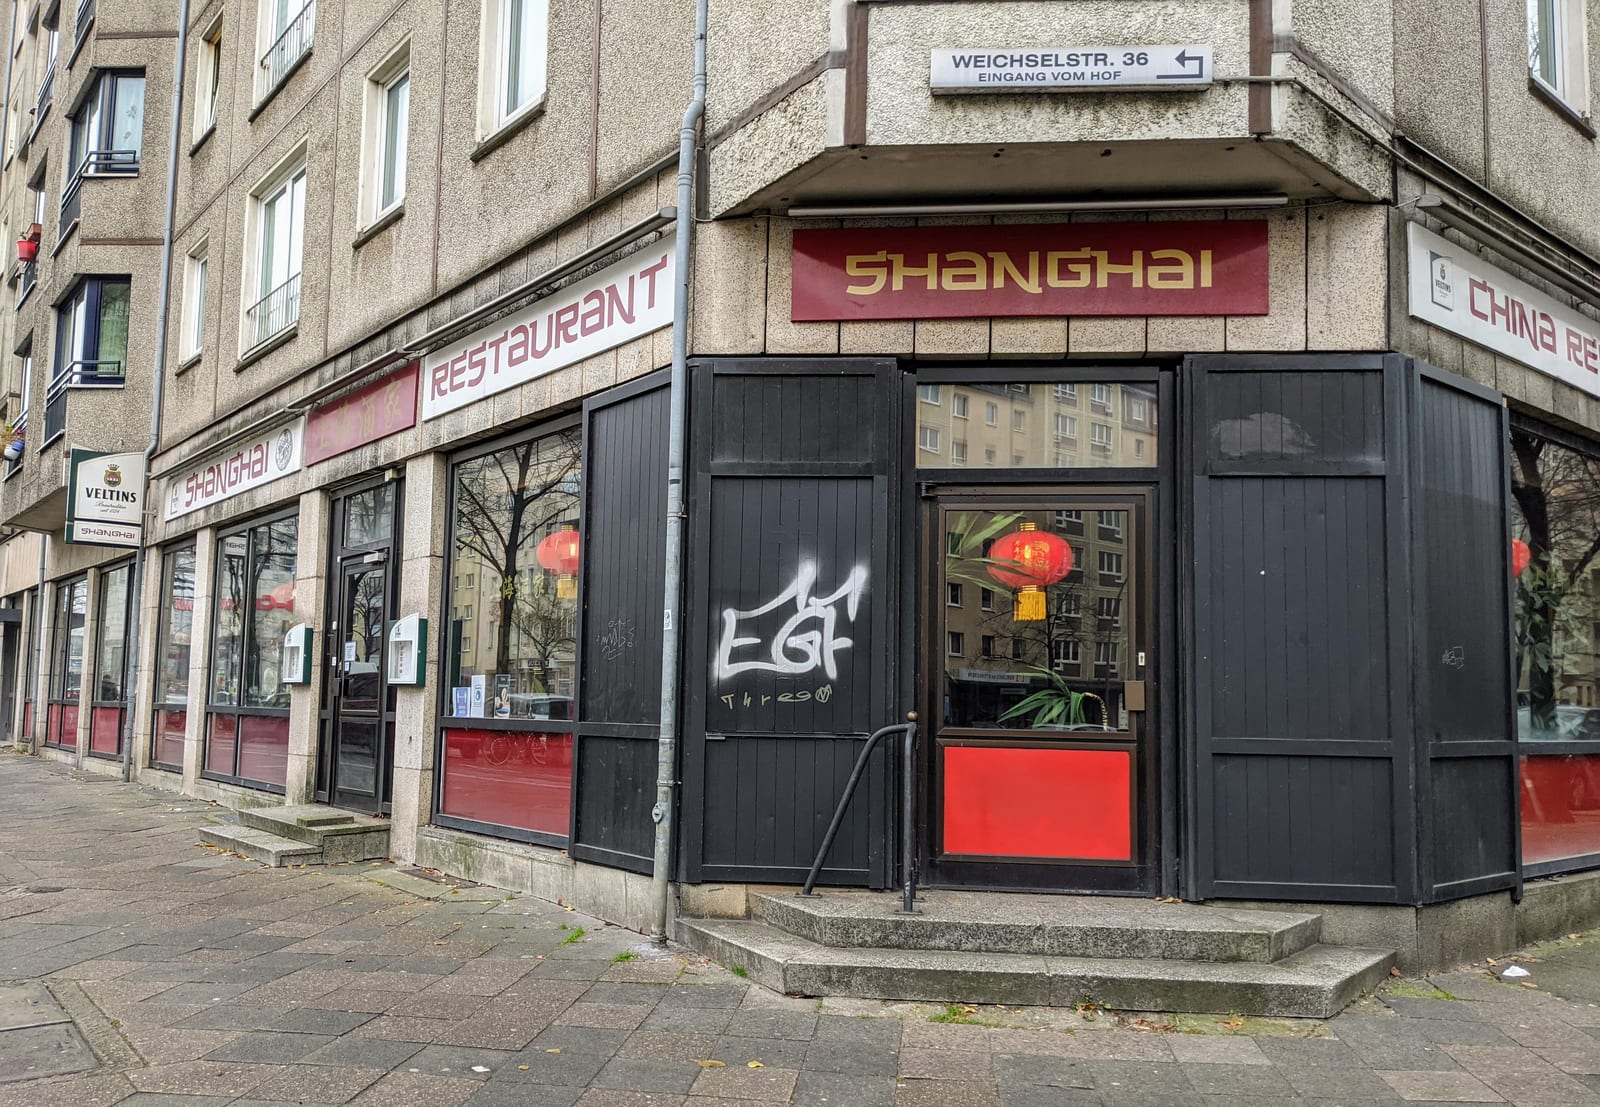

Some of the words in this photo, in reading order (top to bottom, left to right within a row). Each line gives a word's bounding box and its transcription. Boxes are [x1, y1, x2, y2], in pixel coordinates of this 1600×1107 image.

[952, 52, 1115, 68] WEICHSELSTR.
[1122, 52, 1149, 66] 36
[978, 72, 1047, 83] EINGANG
[1051, 71, 1086, 81] VOM
[1090, 71, 1122, 81] HOF
[846, 247, 1213, 294] SHANGHAI
[430, 254, 668, 401] RESTAURANT
[1468, 277, 1557, 355] CHINA
[1566, 327, 1600, 375] RE
[184, 440, 270, 508] SHANGHAI
[85, 487, 137, 503] VELTINS
[81, 527, 136, 540] SHANGHAI
